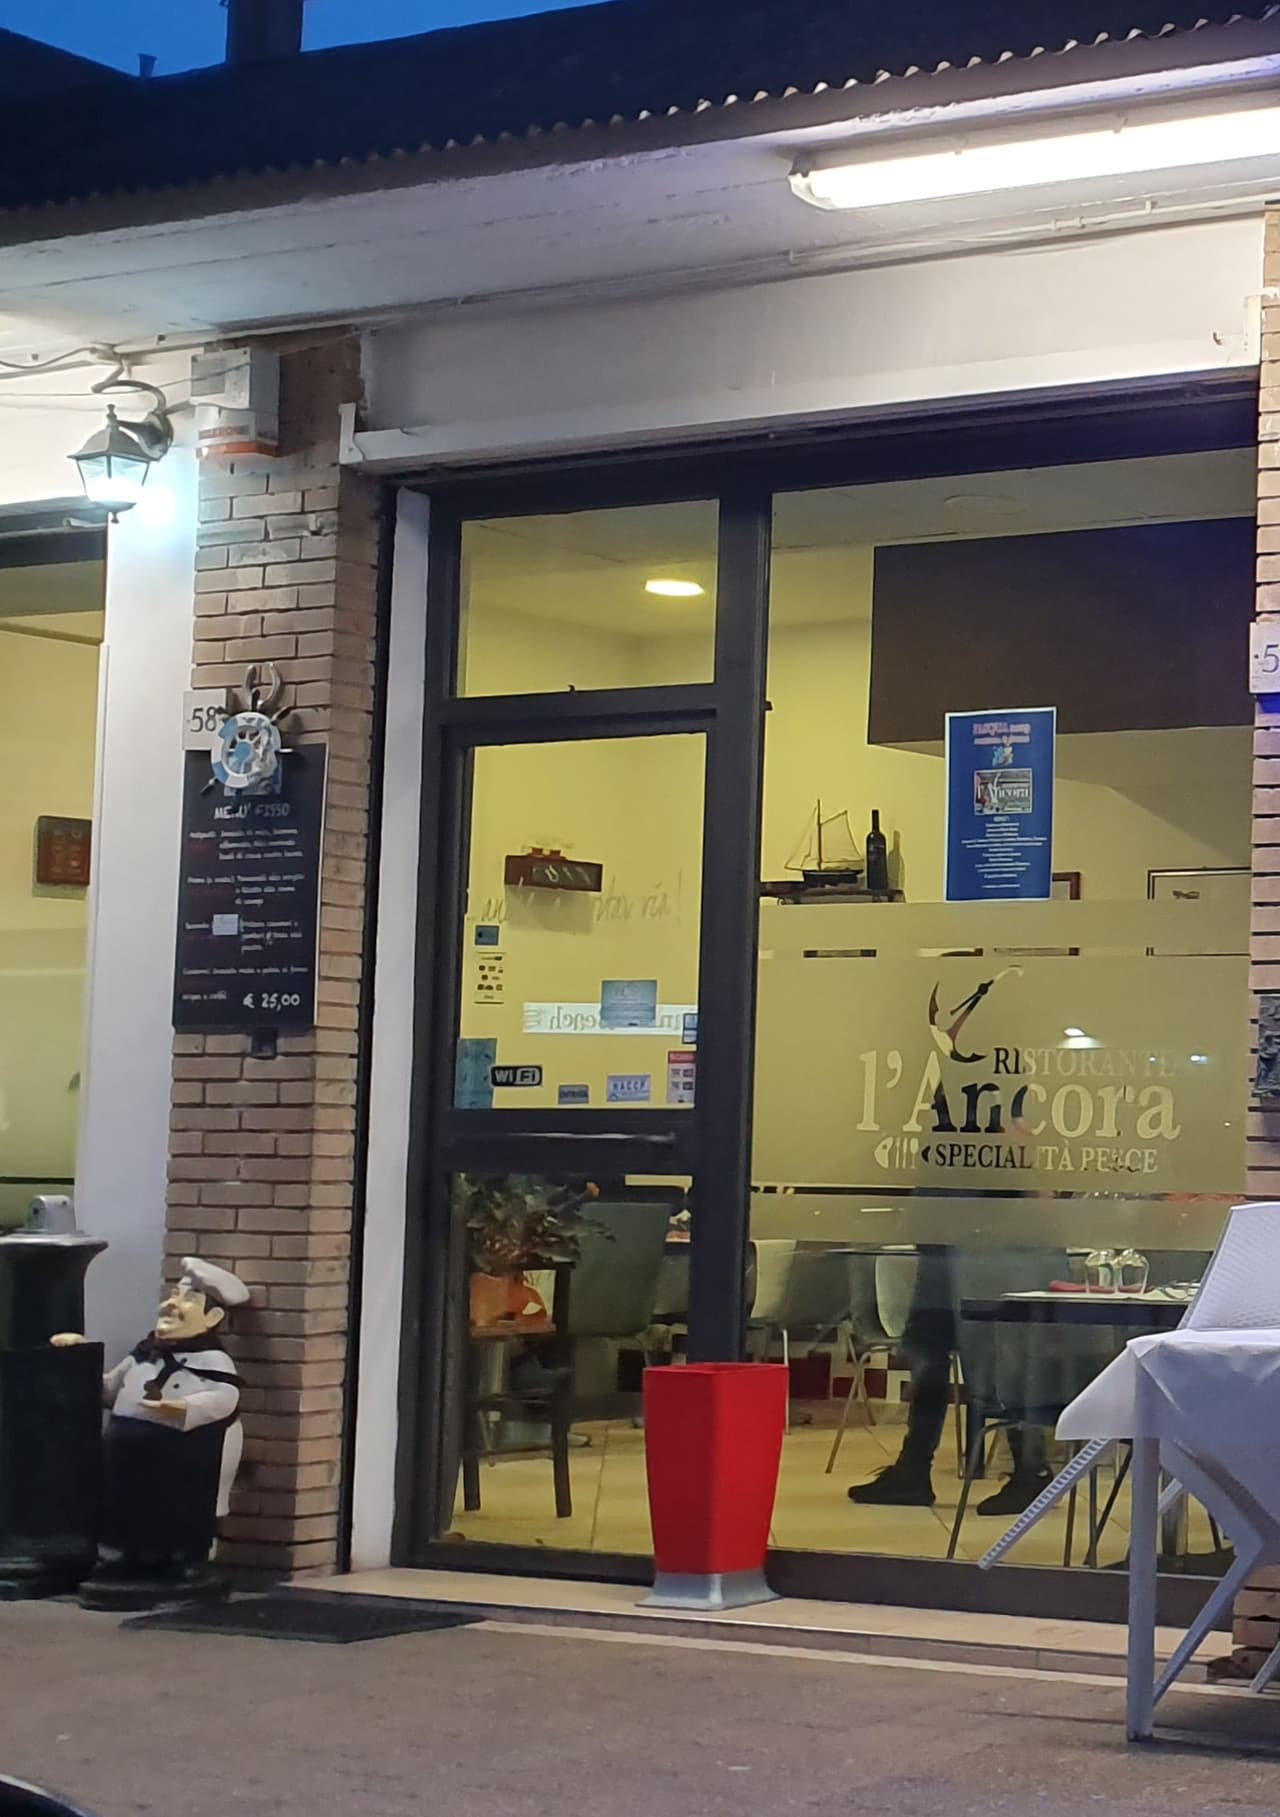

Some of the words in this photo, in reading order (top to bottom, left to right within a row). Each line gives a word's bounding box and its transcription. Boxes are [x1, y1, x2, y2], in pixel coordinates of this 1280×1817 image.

[190, 705, 217, 733] 58
[262, 993, 301, 1011] 25,00
[993, 1047, 1175, 1077] RISTORANTE
[856, 1050, 1181, 1140] l'Ancora
